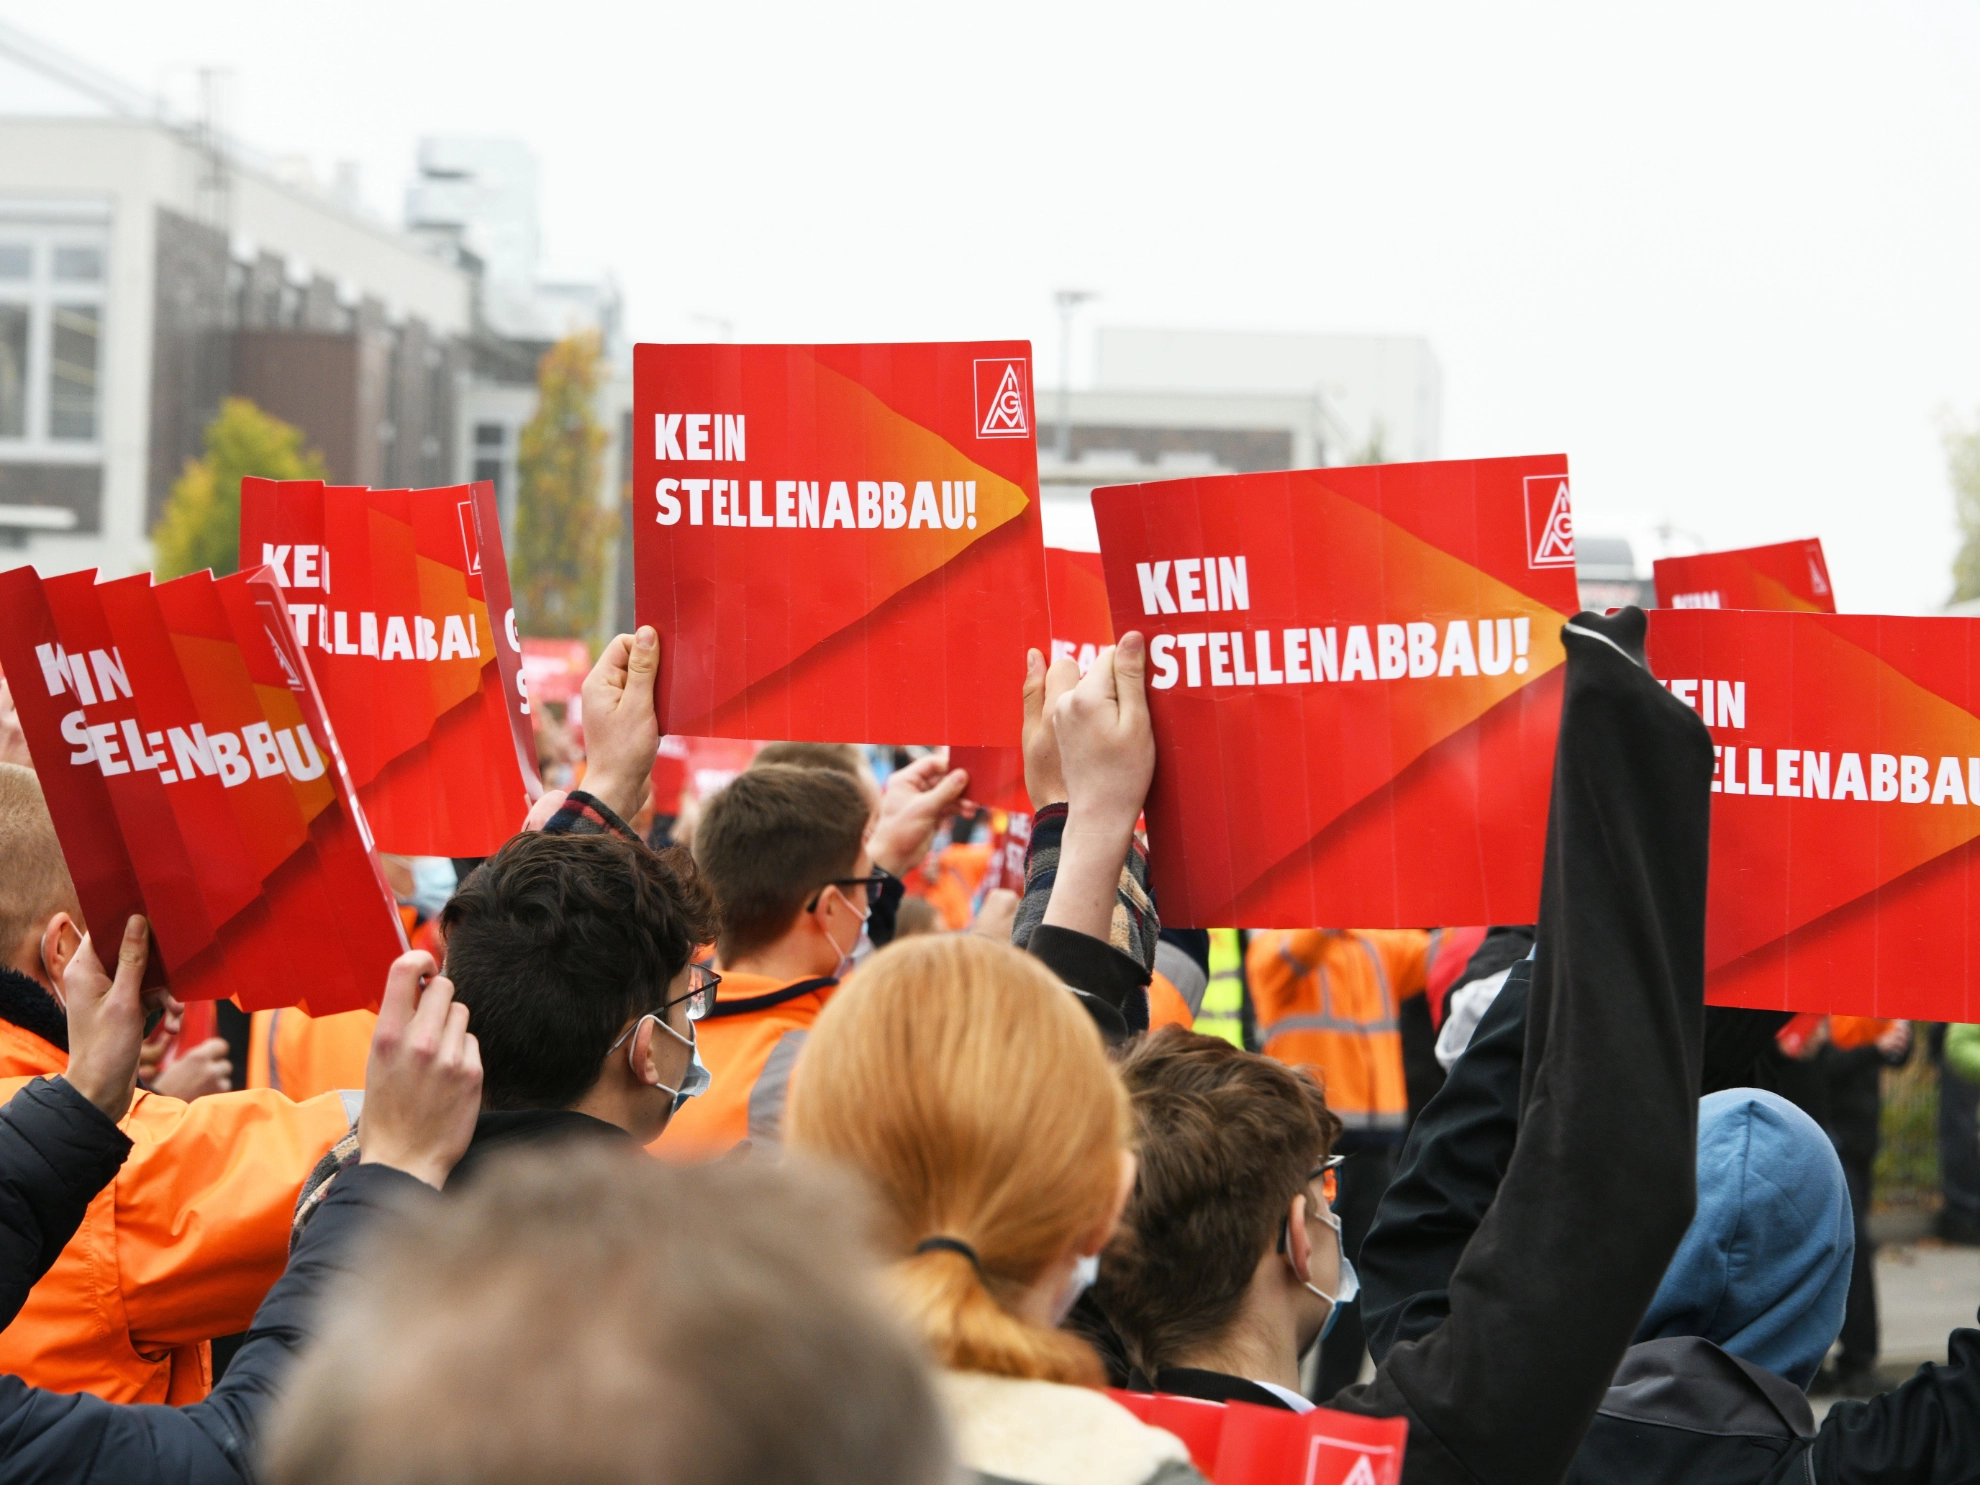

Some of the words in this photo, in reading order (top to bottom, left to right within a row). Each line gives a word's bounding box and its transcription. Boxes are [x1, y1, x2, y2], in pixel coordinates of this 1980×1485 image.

[655, 413, 745, 461] KEIN
[655, 478, 977, 529] STELLENABBAU!
[1136, 556, 1250, 615] KEIN
[1150, 617, 1530, 690] STELLENABBAU!
[1657, 679, 1746, 729] EIN
